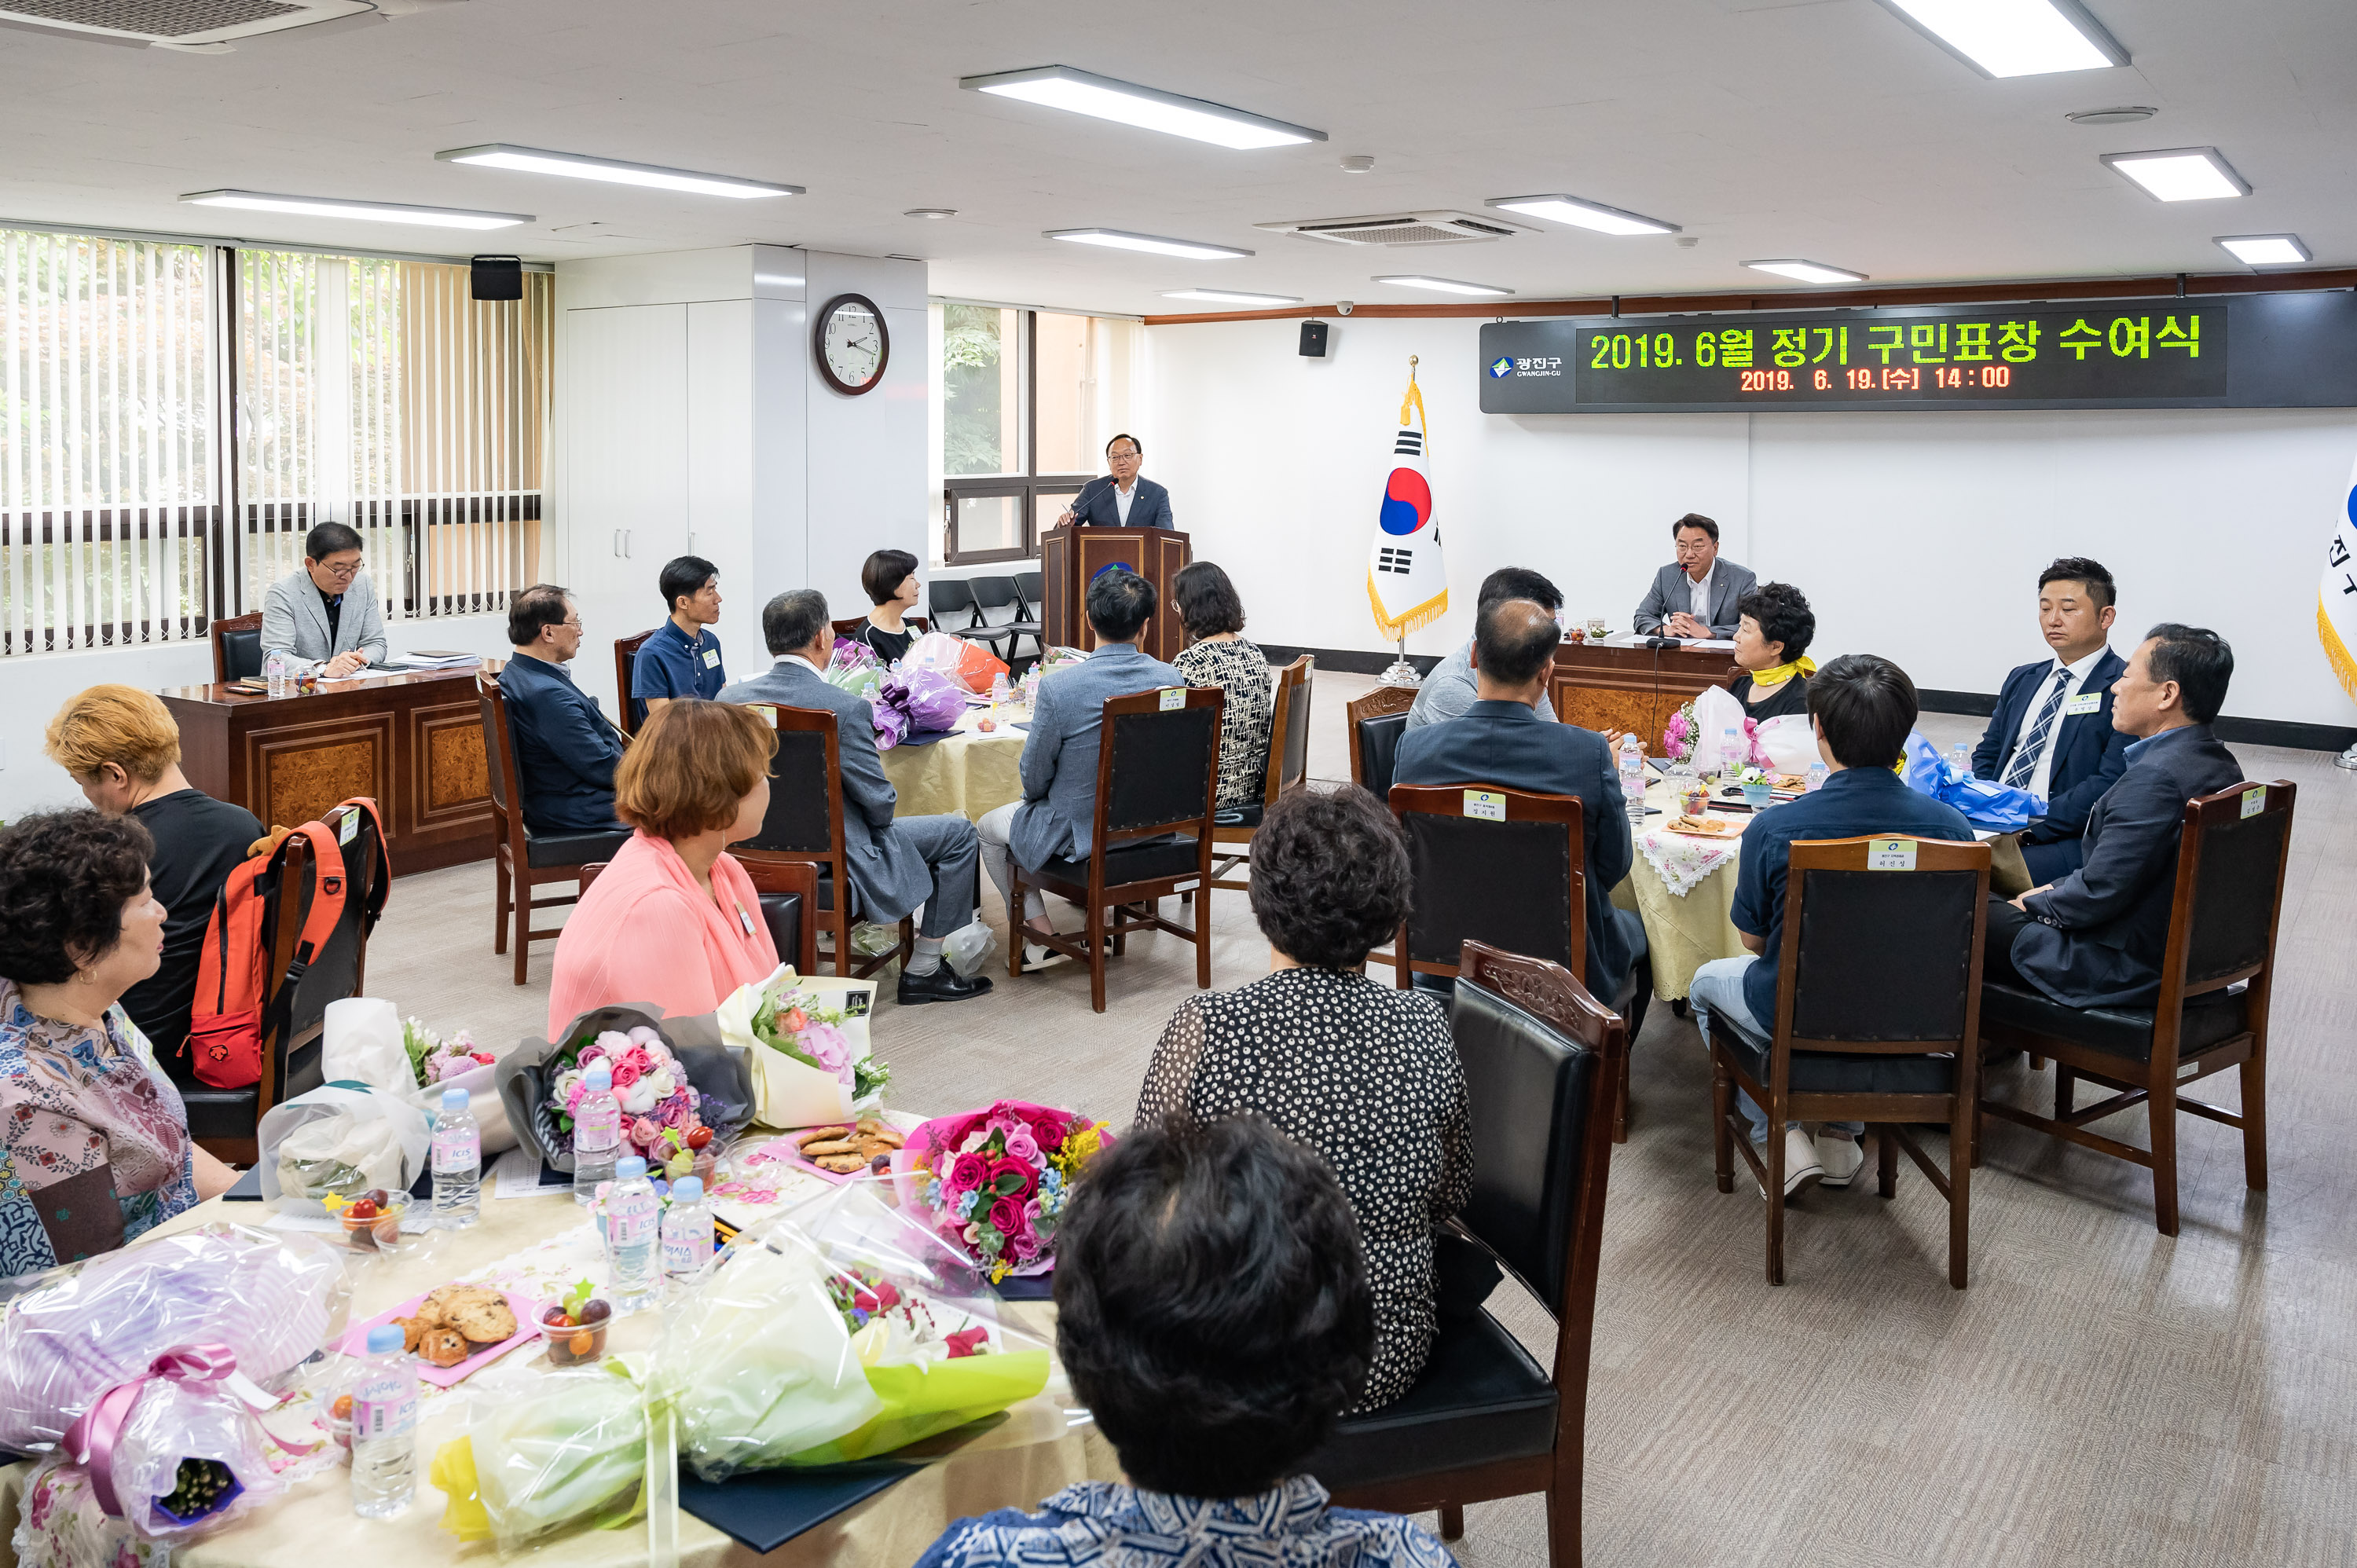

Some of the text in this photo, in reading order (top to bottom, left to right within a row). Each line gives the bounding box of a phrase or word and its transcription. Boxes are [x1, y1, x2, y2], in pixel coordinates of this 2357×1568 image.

[829, 323, 836, 335] 10
[869, 323, 874, 335] 2
[825, 338, 830, 350] 9
[873, 340, 878, 352] 3
[1591, 315, 2200, 369] 2019. 6월 정기 구민표창 수여식
[828, 354, 834, 366] 8
[869, 356, 874, 368] 4
[1516, 357, 1562, 371] 광진구
[838, 366, 843, 377] 7
[849, 371, 855, 383] 6
[860, 368, 866, 378] 5
[1741, 371, 1794, 392] 2019.
[1813, 369, 1832, 390] 6.
[453, 1148, 471, 1157] ICIS
